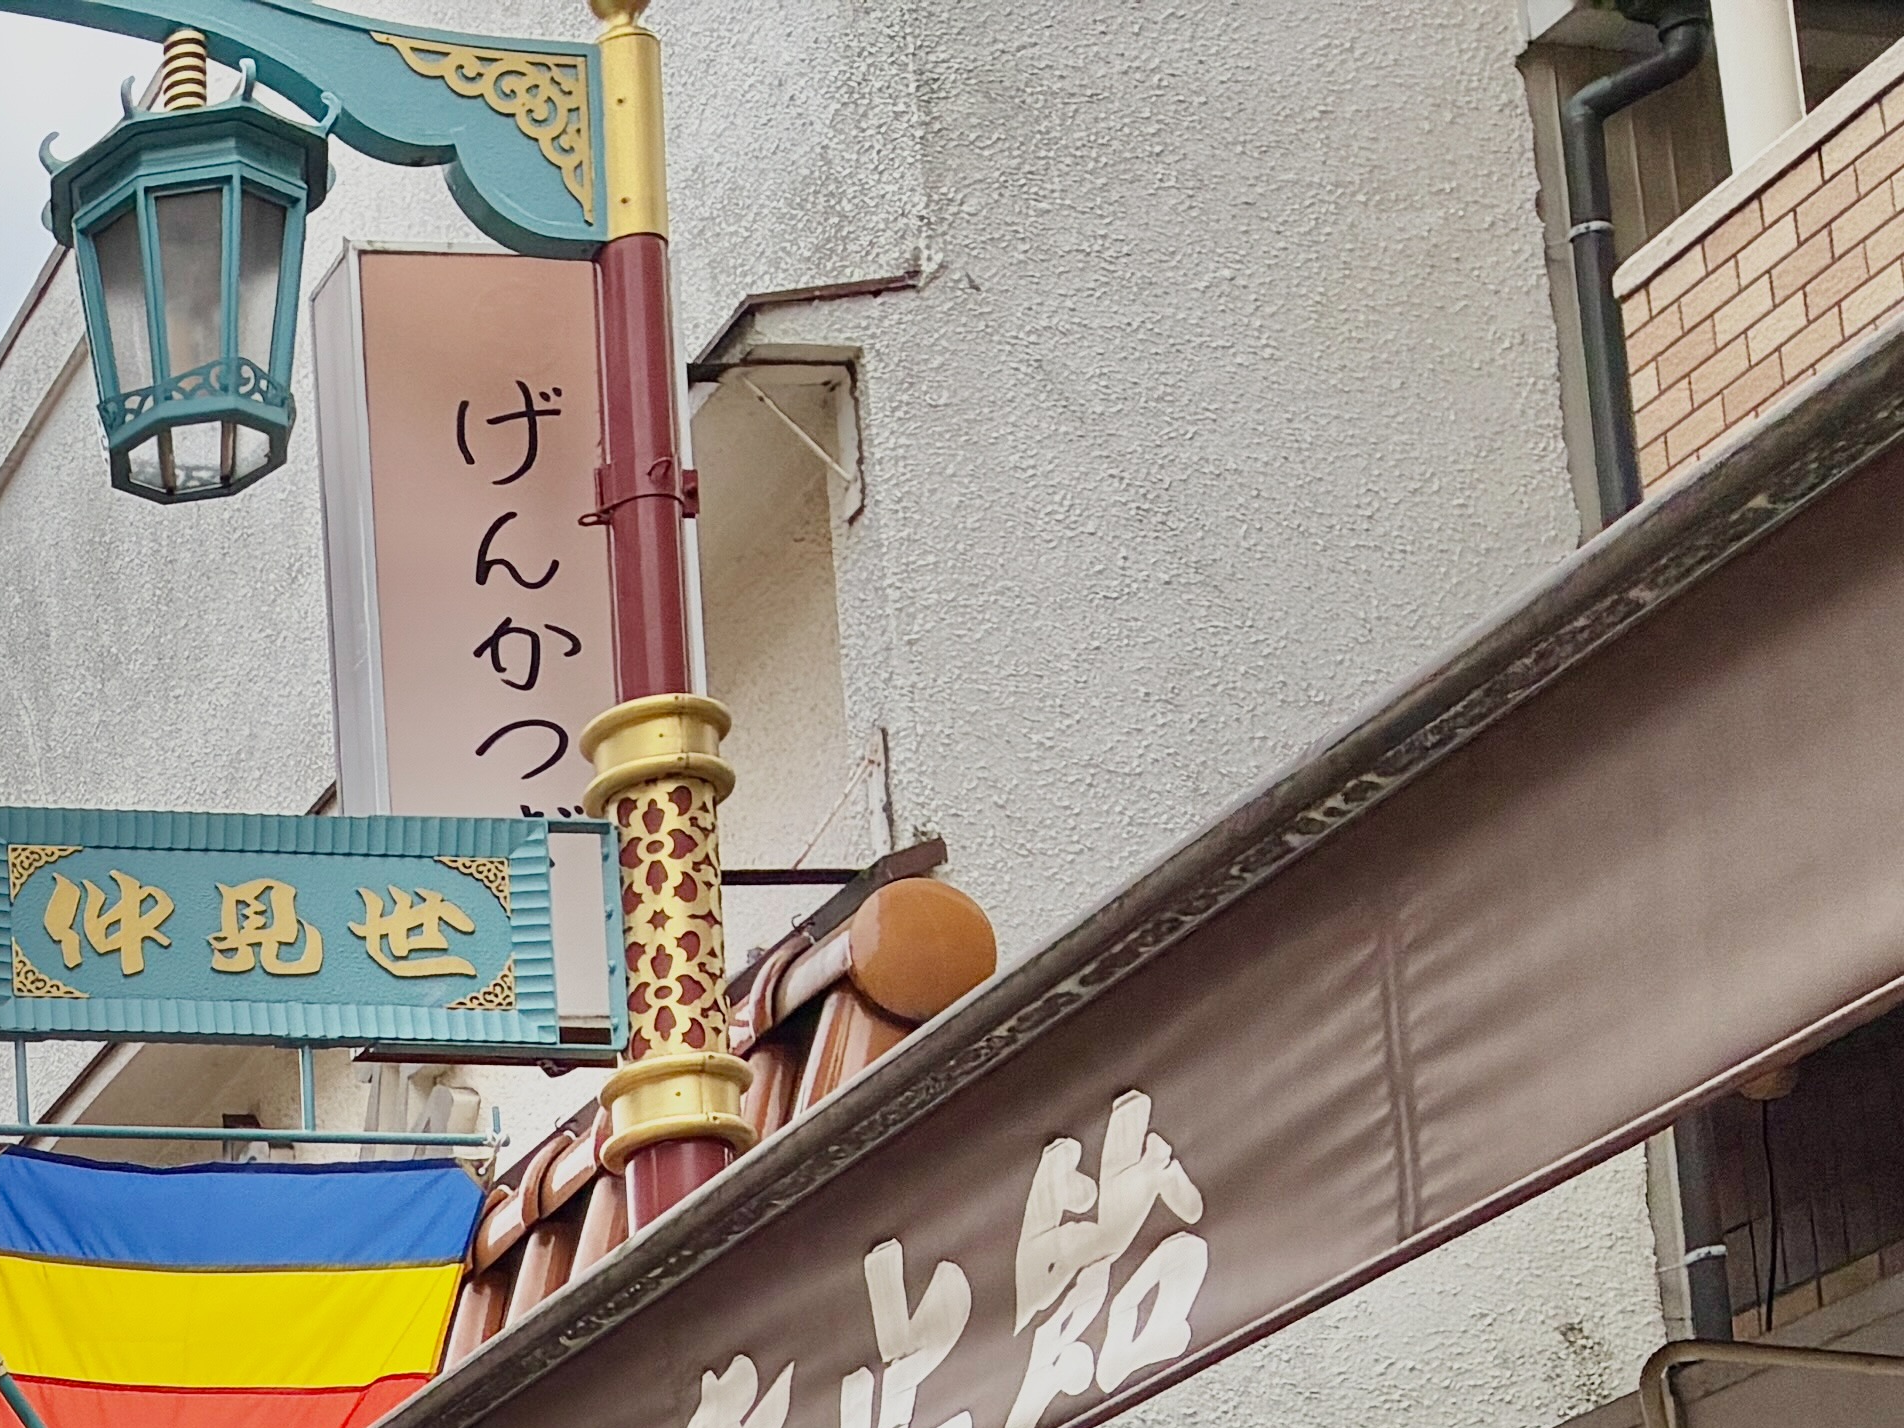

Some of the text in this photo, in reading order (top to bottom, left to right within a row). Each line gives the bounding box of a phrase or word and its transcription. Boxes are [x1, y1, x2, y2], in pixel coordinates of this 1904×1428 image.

[455, 380, 584, 822] げんかつ
[41, 869, 480, 981] 仲見世
